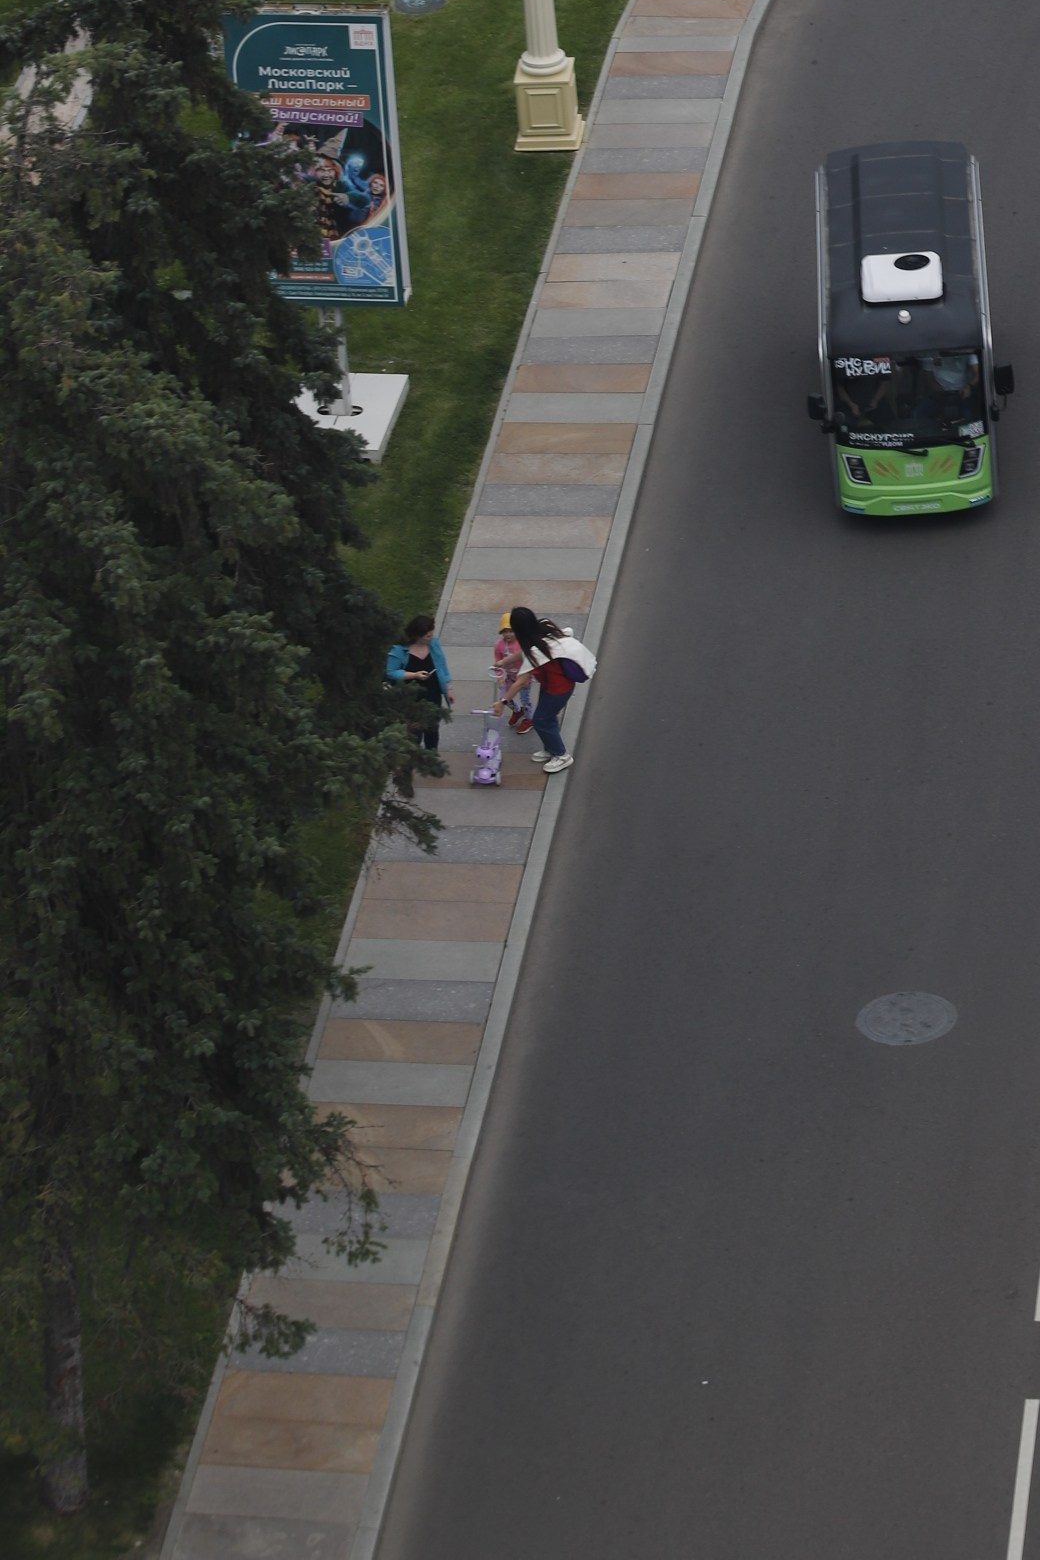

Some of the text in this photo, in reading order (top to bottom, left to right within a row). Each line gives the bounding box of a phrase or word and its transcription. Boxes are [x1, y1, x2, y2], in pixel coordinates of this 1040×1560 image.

[258, 66, 350, 78] Московский
[267, 78, 345, 91] ЛисаПарк
[255, 95, 365, 108] аш идеальный
[269, 108, 359, 123] Выпускной!
